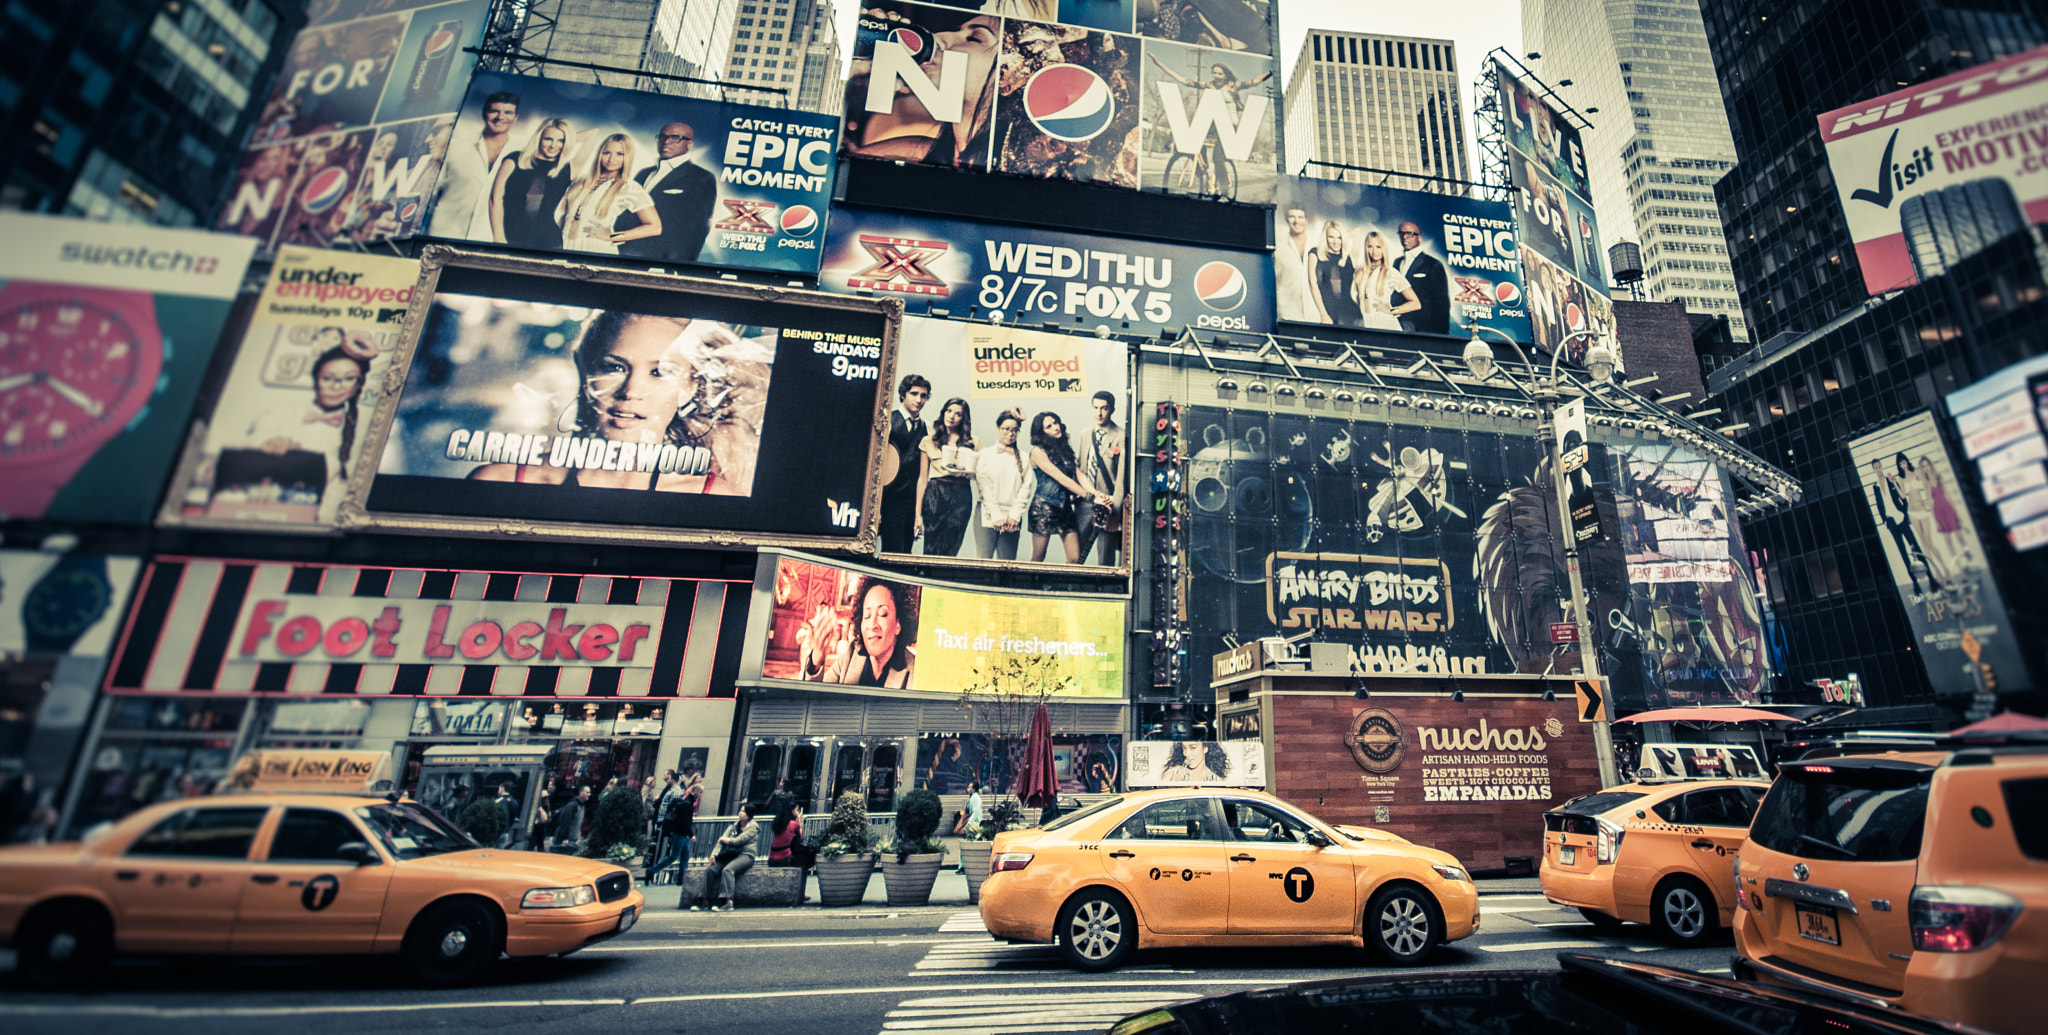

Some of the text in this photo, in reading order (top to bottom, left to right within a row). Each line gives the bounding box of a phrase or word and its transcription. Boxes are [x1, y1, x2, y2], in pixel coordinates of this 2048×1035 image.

[286, 58, 374, 100] FOR
[731, 117, 834, 140] CATCH EVERY
[723, 131, 831, 175] EPIC
[721, 166, 826, 193] MOMENT
[1443, 213, 1511, 230] CATCH EVERY
[1443, 224, 1516, 259] EPIC
[60, 243, 193, 274] swatch
[1448, 252, 1518, 273] MOMENT
[279, 267, 363, 286] under
[858, 281, 940, 294] FACTOR
[276, 281, 415, 305] employed
[979, 275, 1172, 323] 8/7c FOX 5
[269, 303, 341, 318] tuesdays
[346, 306, 374, 319] 10p
[1197, 313, 1249, 331] pepsi
[782, 328, 881, 347] BEHIND THE MUSIC
[813, 341, 880, 359] SUNDAYS
[974, 343, 1036, 360] under
[831, 355, 879, 381] 9pm
[975, 355, 1080, 377] employed
[976, 379, 1031, 390] tuesdays
[1034, 379, 1055, 390] 10p
[446, 429, 712, 476] CARRIE UNDERWOOD
[1279, 565, 1440, 606] ANGRY BIRDS
[1282, 607, 1362, 630] STAR
[240, 600, 652, 661] Foot Locker
[934, 629, 968, 649] Taxi
[972, 634, 996, 652] air
[1216, 649, 1253, 678] nuchas
[1417, 718, 1547, 751] nuchas
[331, 757, 373, 778] KING
[1422, 755, 1548, 765] ARTISAN HAND-HELD FOODS
[1380, 775, 1400, 783] Square
[1422, 768, 1549, 778] PASTRIES COFFEE
[1491, 777, 1550, 785] CHOCOLATE
[1423, 785, 1552, 801] EMPANADAS
